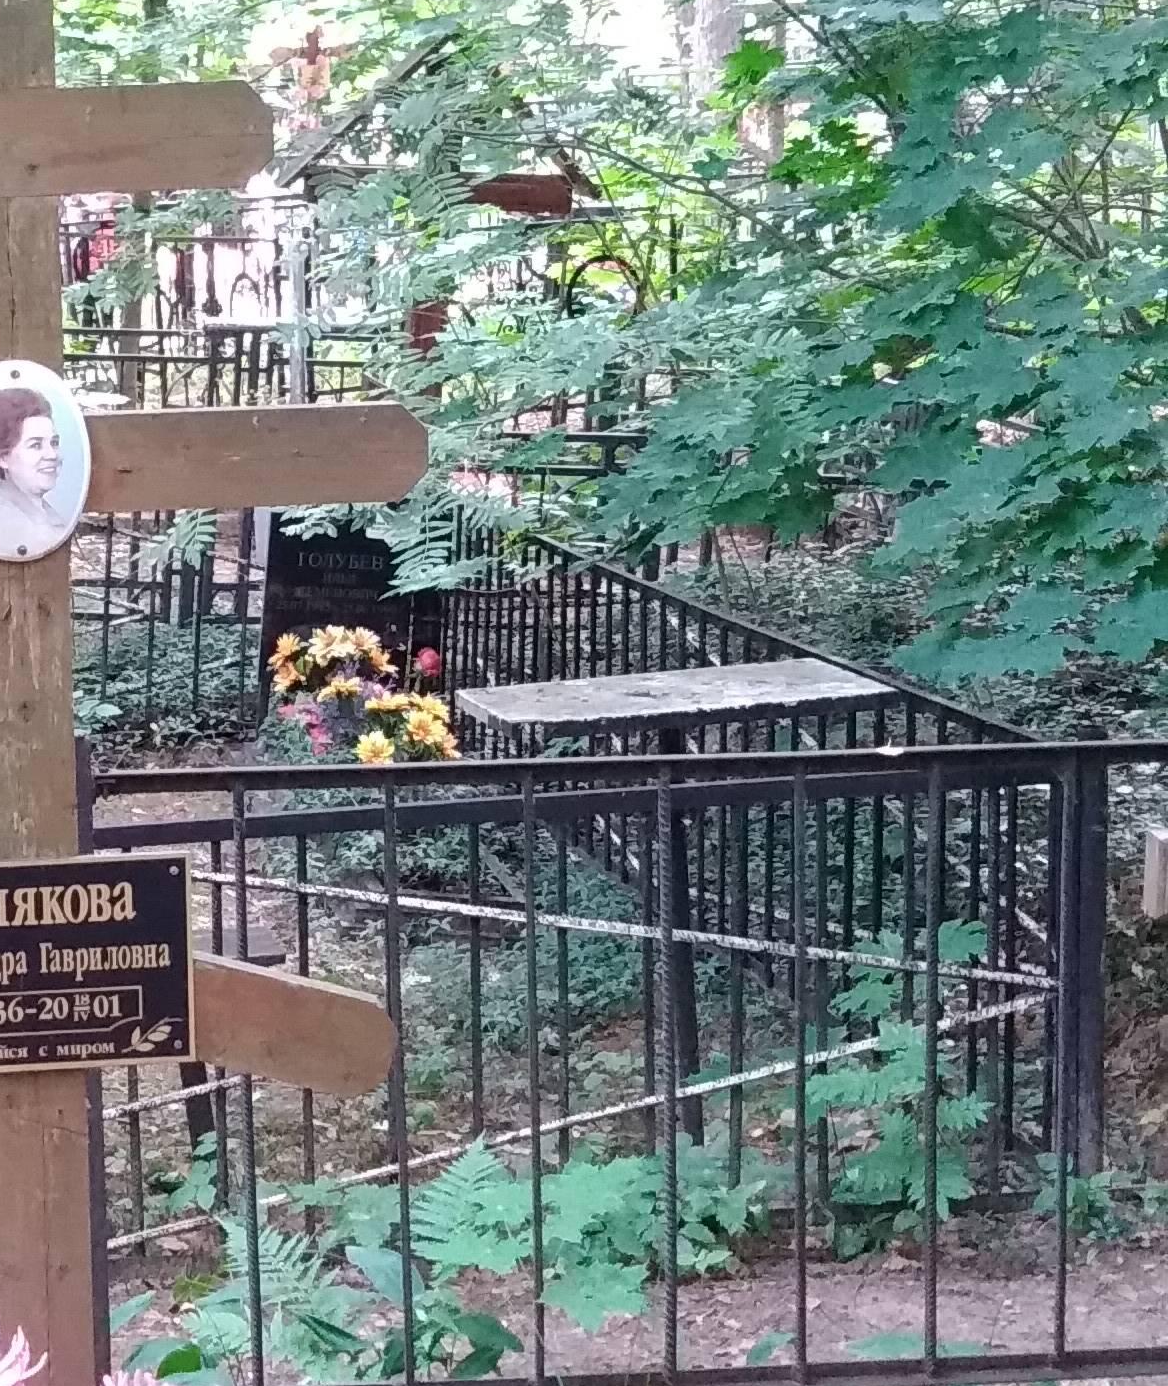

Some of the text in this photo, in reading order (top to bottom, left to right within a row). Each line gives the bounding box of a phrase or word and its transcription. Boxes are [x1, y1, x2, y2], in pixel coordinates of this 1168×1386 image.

[39, 942, 171, 981] Гавриловна
[38, 1045, 48, 1056] с
[56, 1041, 115, 1059] миром
